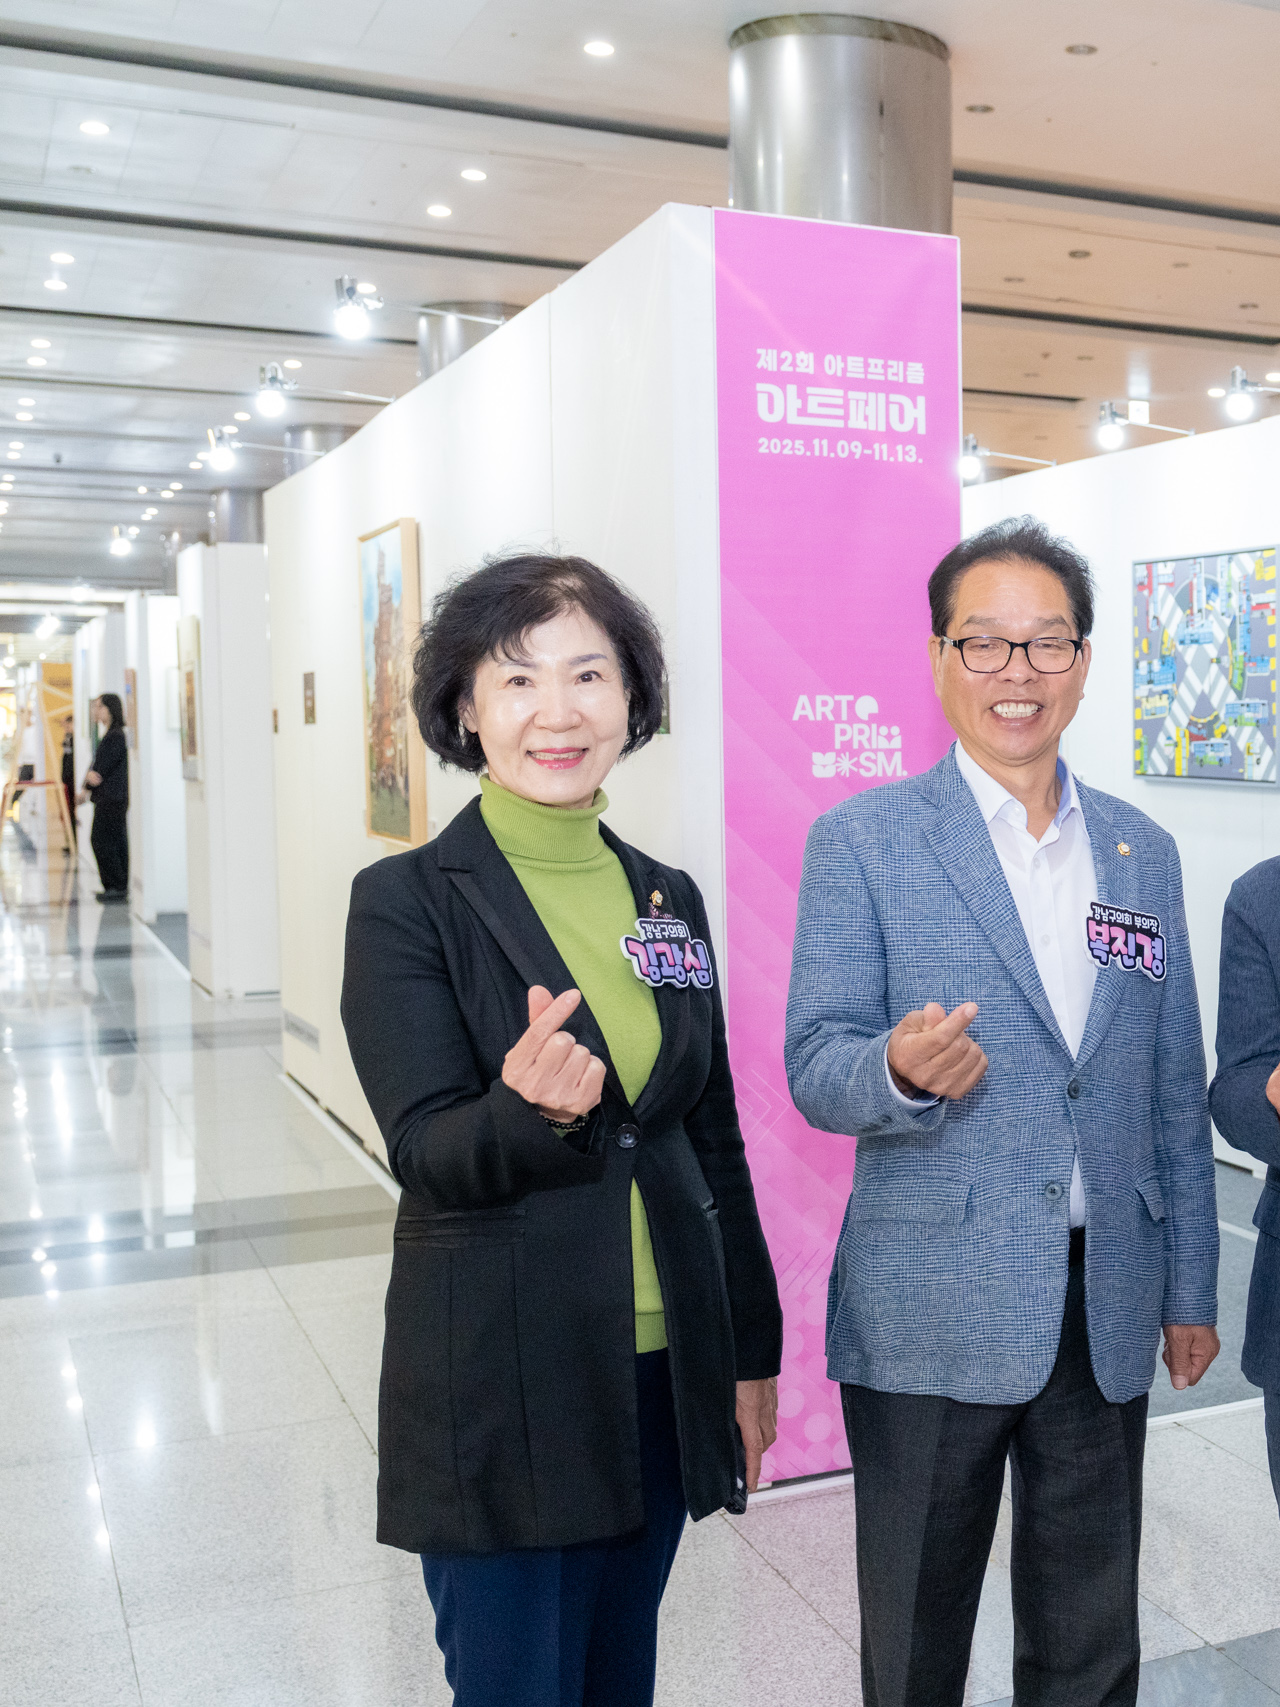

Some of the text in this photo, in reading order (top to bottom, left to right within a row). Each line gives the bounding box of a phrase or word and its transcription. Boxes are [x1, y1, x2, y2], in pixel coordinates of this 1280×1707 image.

[756, 348, 925, 385] 제2회 아트프리즘
[756, 382, 926, 435] 아트페어
[757, 437, 924, 463] 2025.11.09-11.13.
[792, 695, 854, 721] ART
[641, 923, 688, 940] 강남구의회
[1092, 905, 1159, 933] 강남구의회 부의장
[1088, 919, 1164, 977] 복진경
